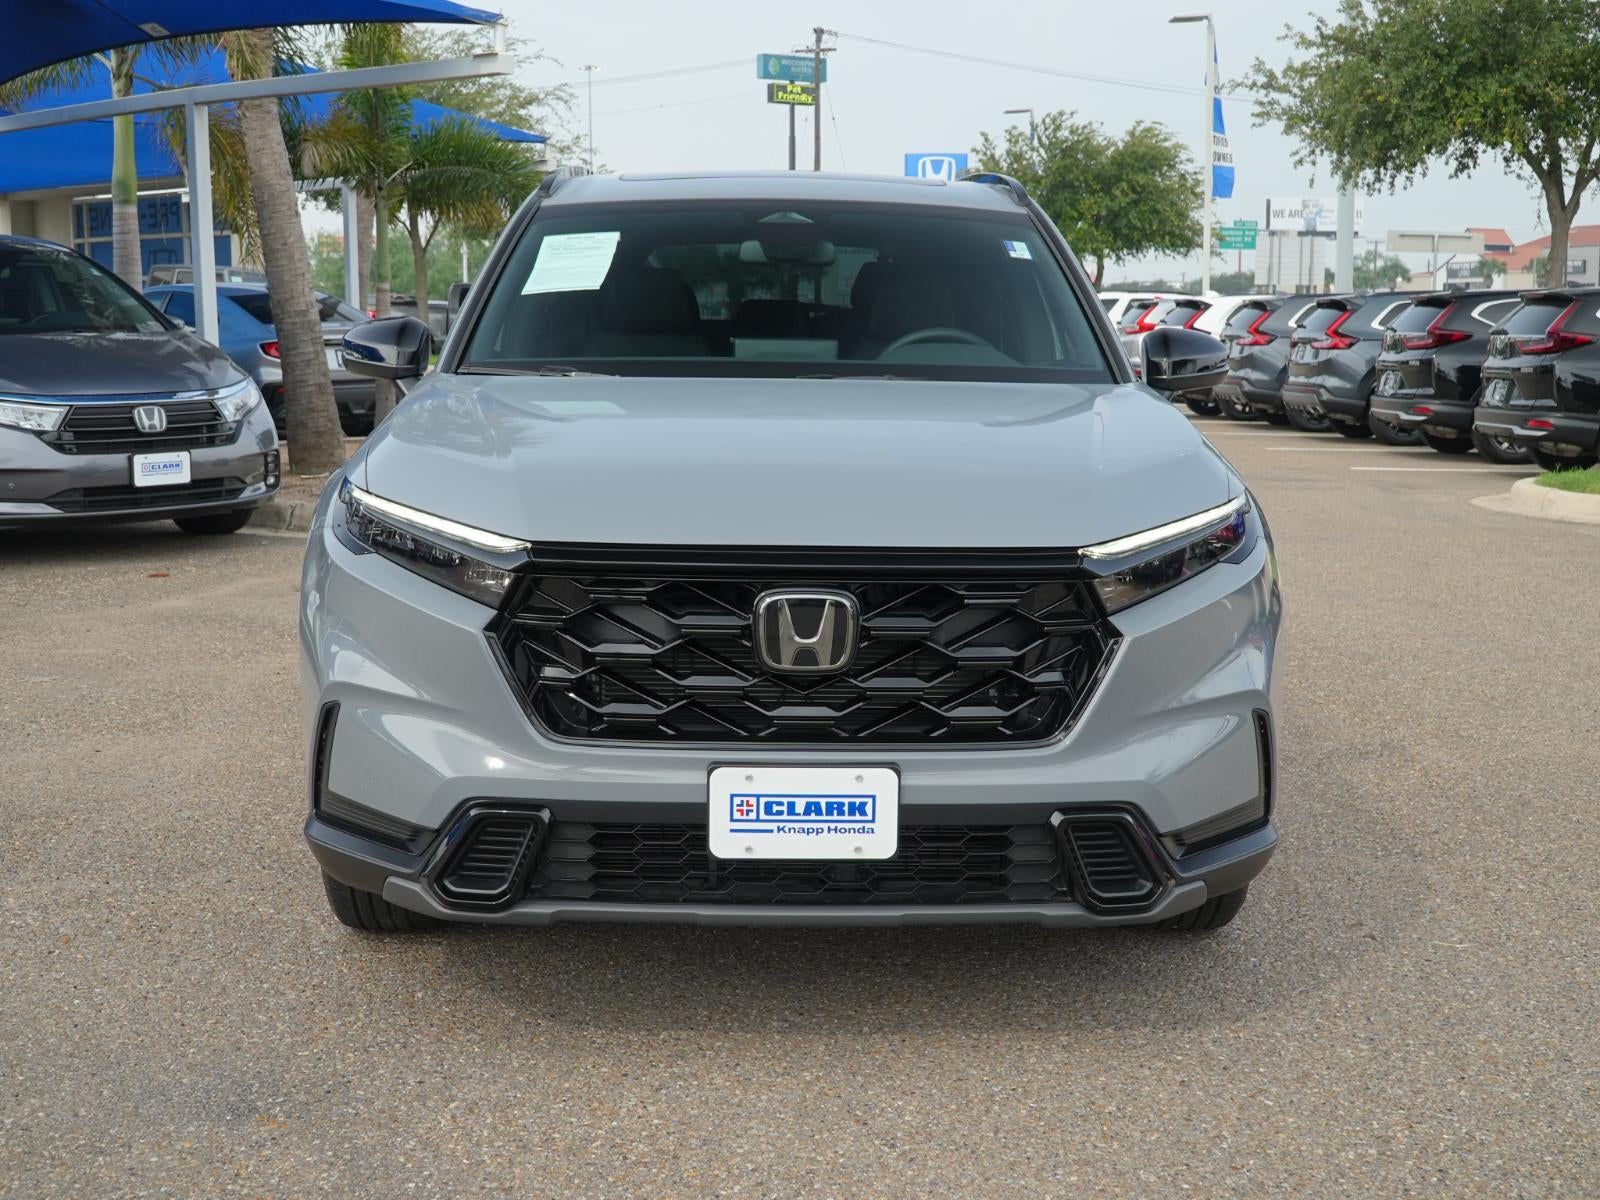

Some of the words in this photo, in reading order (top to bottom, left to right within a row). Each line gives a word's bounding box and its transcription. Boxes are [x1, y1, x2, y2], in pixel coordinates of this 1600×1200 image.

[787, 84, 802, 94] Pet
[778, 92, 813, 103] Friendly
[1272, 209, 1286, 219] WE
[763, 800, 869, 817] CLARK
[776, 825, 825, 836] Knapp
[827, 825, 875, 834] Honda
